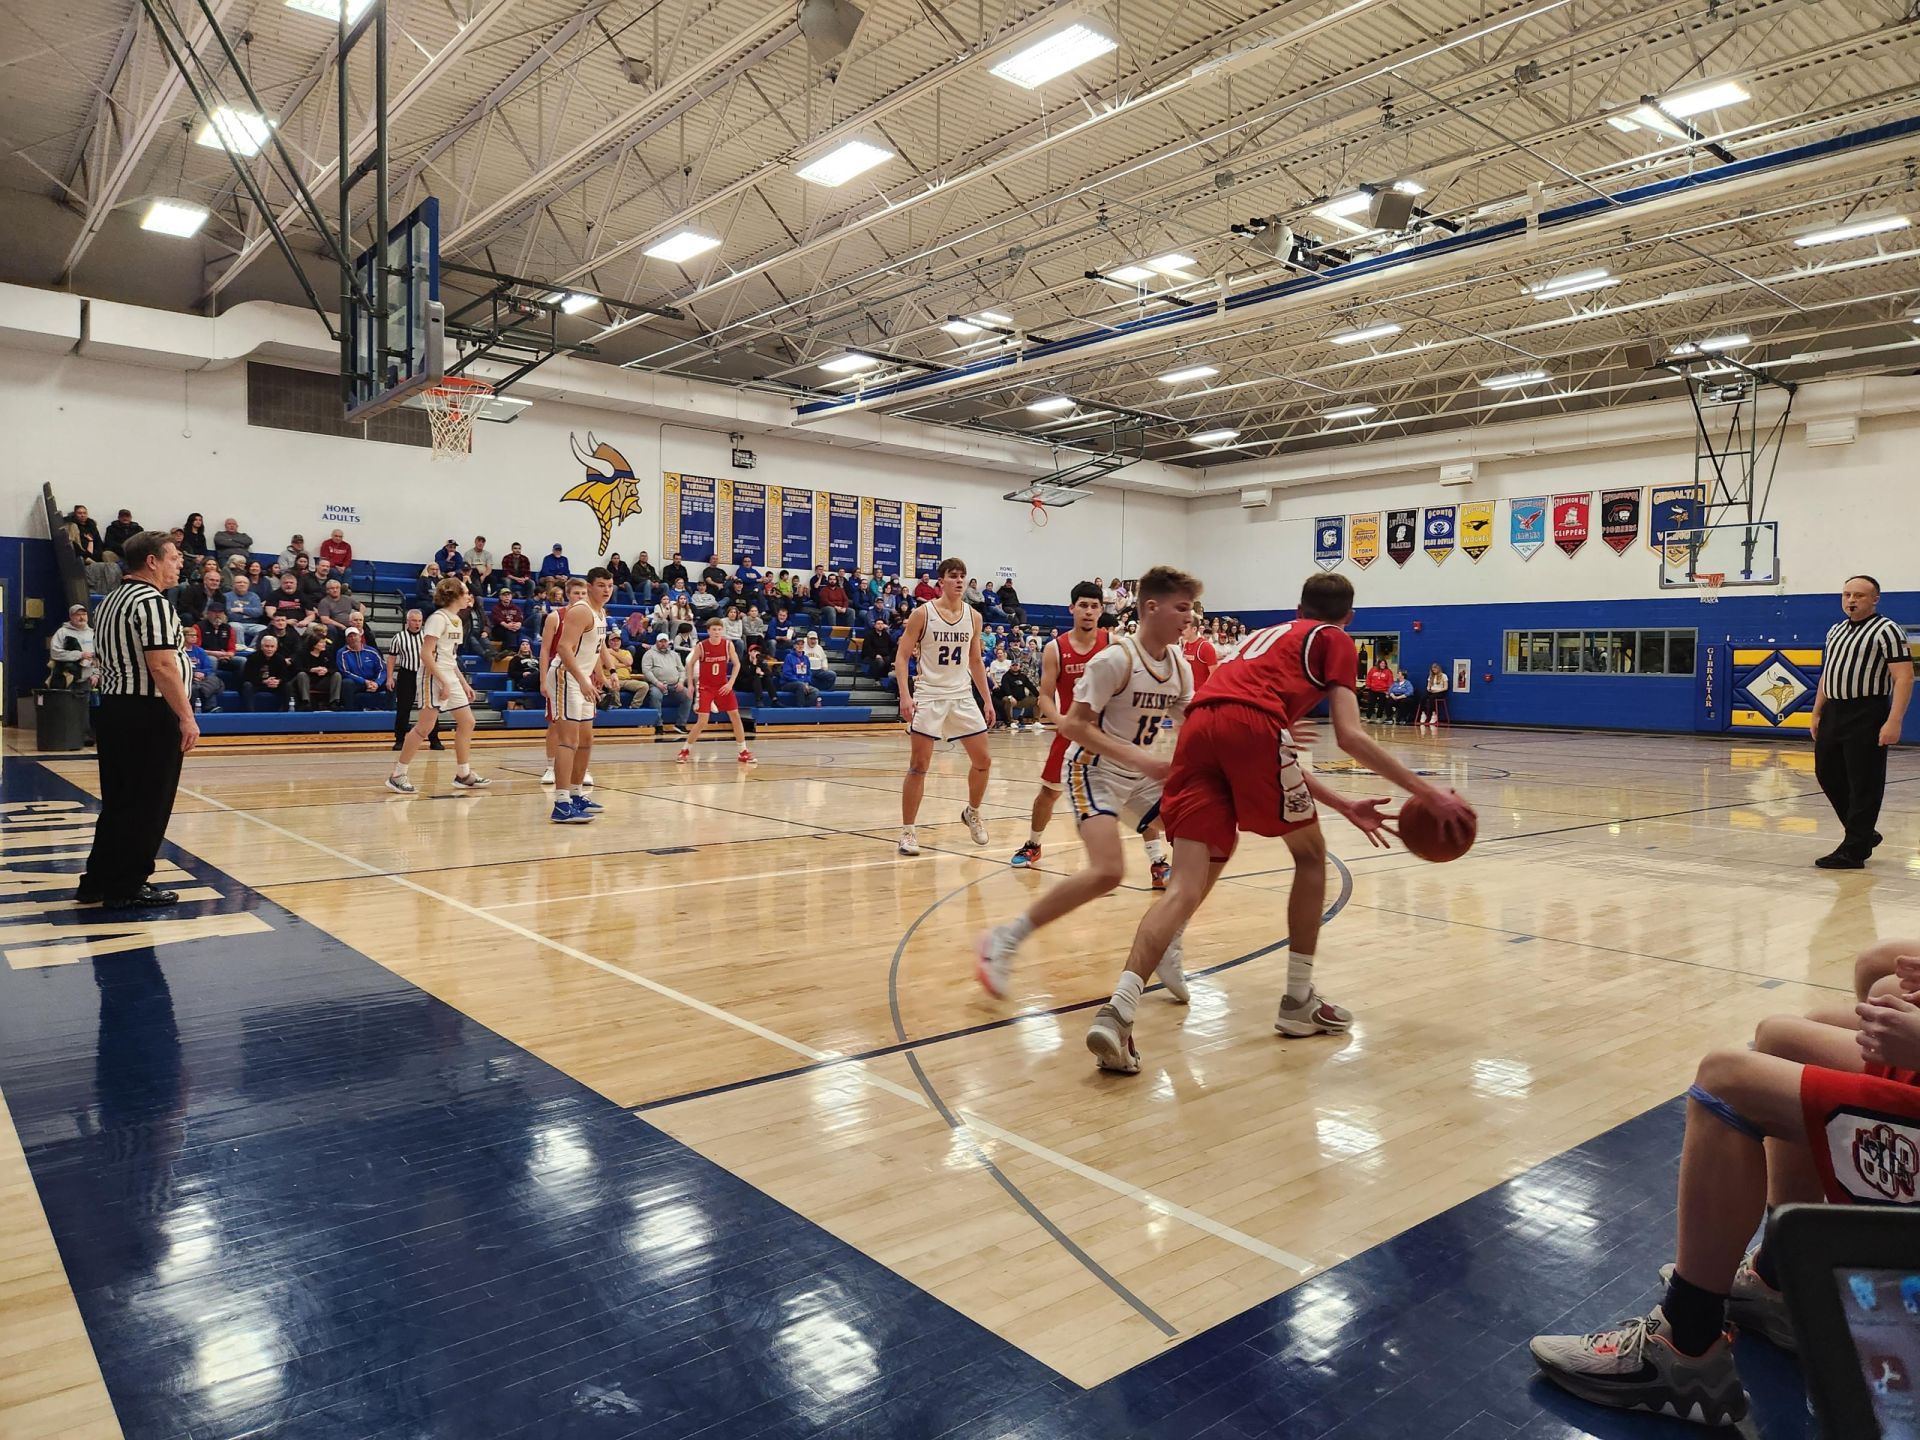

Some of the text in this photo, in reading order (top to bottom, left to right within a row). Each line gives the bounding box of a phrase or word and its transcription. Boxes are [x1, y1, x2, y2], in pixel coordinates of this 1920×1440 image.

[1654, 488, 1704, 505] GIBRALTR
[326, 505, 356, 514] HOME
[1428, 509, 1452, 519] OCONTO
[322, 514, 361, 522] ADULTS
[933, 631, 969, 642] VIKINGS
[938, 646, 962, 665] 24
[712, 663, 720, 676] 0
[1705, 648, 1714, 707] GIBRALTAR
[1132, 691, 1178, 710] VIKING
[1132, 716, 1162, 745] 15
